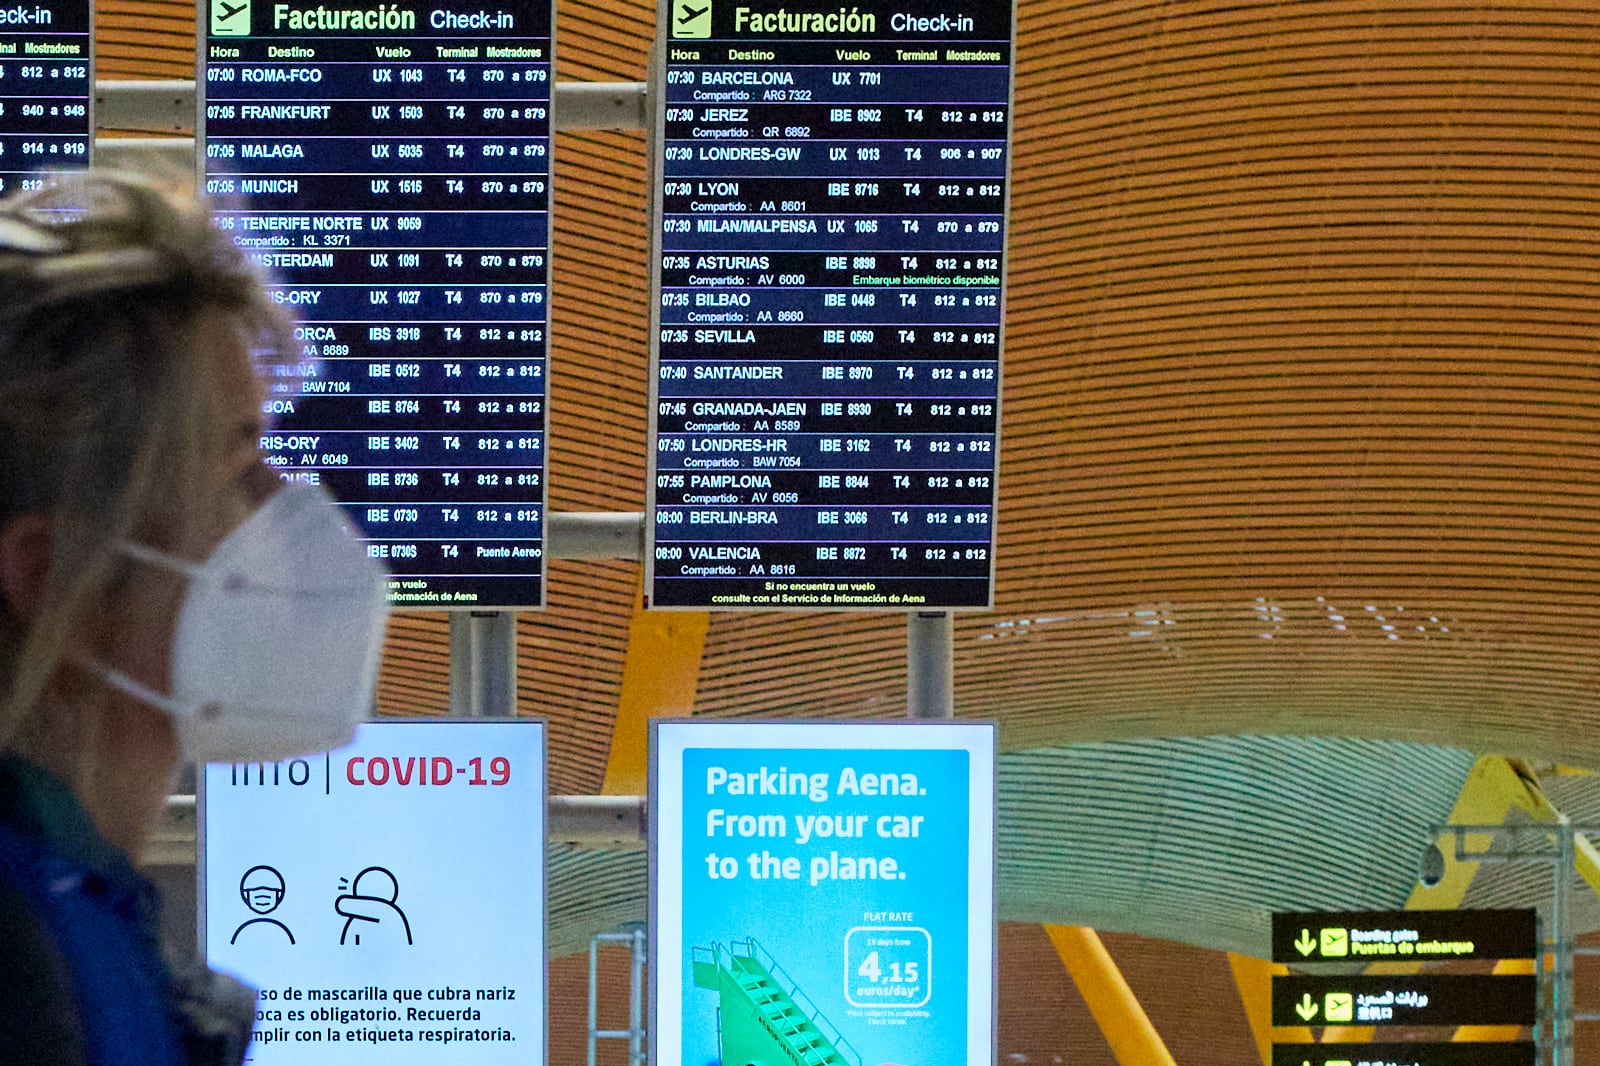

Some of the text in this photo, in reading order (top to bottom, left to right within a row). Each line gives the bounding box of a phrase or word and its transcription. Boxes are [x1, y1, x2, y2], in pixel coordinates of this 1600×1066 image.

[274, 4, 514, 30] Facturación Check-in
[735, 7, 974, 33] Facturación Check-in
[242, 69, 322, 82] ROMA-FCO
[702, 72, 793, 85] BARCELONA
[241, 106, 331, 119] FRANKFURT
[700, 108, 748, 122] JEREZ
[241, 145, 304, 158] MALAGA
[699, 148, 801, 161] LONDRES-GW
[241, 180, 298, 194] MUNICH
[699, 183, 739, 196] LYON
[241, 217, 362, 231] TENERIFE NORTE
[698, 220, 817, 234] MILAN/MALPENSA
[697, 257, 769, 270] ASTURIAS
[696, 293, 750, 307] BILBAO
[695, 330, 755, 343] SEVILLA
[694, 366, 783, 380] SANTANDER
[692, 403, 807, 417] GRANADA-JAEN
[692, 439, 787, 452] LONDRES-HR
[691, 476, 771, 489] PAMPLONA
[690, 512, 778, 525] BERLIN-BRA
[689, 548, 761, 561] VALENCIA
[346, 757, 511, 786] COVID-19
[707, 767, 927, 802] Parking Aena.
[707, 809, 924, 844] From your car
[706, 851, 906, 886] to the plane.
[863, 912, 913, 922] FLAT RATE
[858, 951, 918, 984] 4,15
[258, 987, 515, 1003] so de mascarilla que cubra nariz
[256, 1007, 481, 1024] oca es obligatorio. Recuerda
[295, 1029, 322, 1042] con
[327, 1028, 341, 1042] la
[346, 1028, 413, 1045] etiqueta
[419, 1028, 516, 1045] respiratoria.
